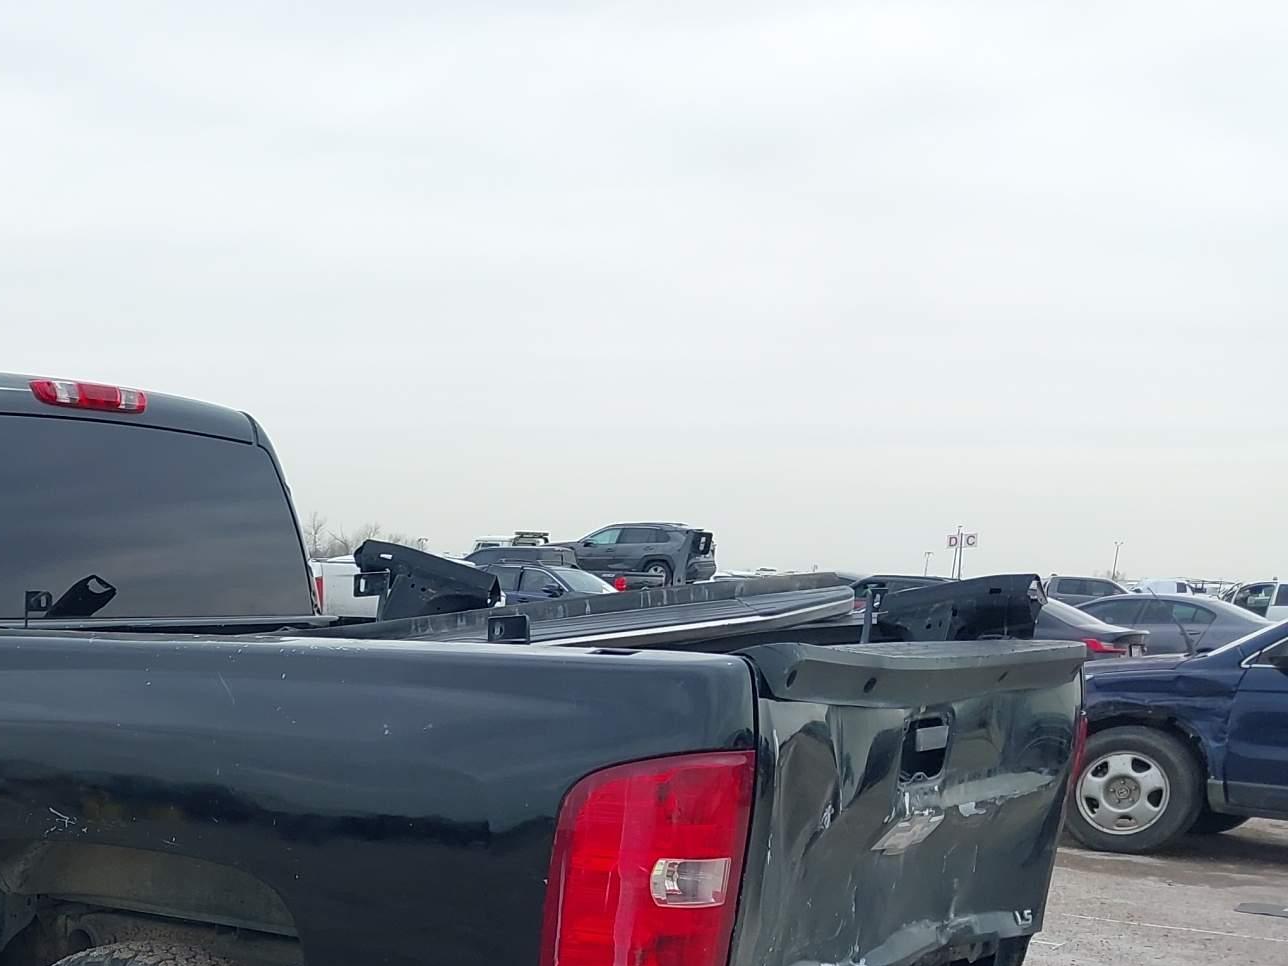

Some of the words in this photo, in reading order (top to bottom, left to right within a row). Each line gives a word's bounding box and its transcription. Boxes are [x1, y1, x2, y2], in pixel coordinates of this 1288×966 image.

[949, 536, 958, 547] D
[966, 535, 976, 546] C
[1014, 909, 1033, 927] LS
